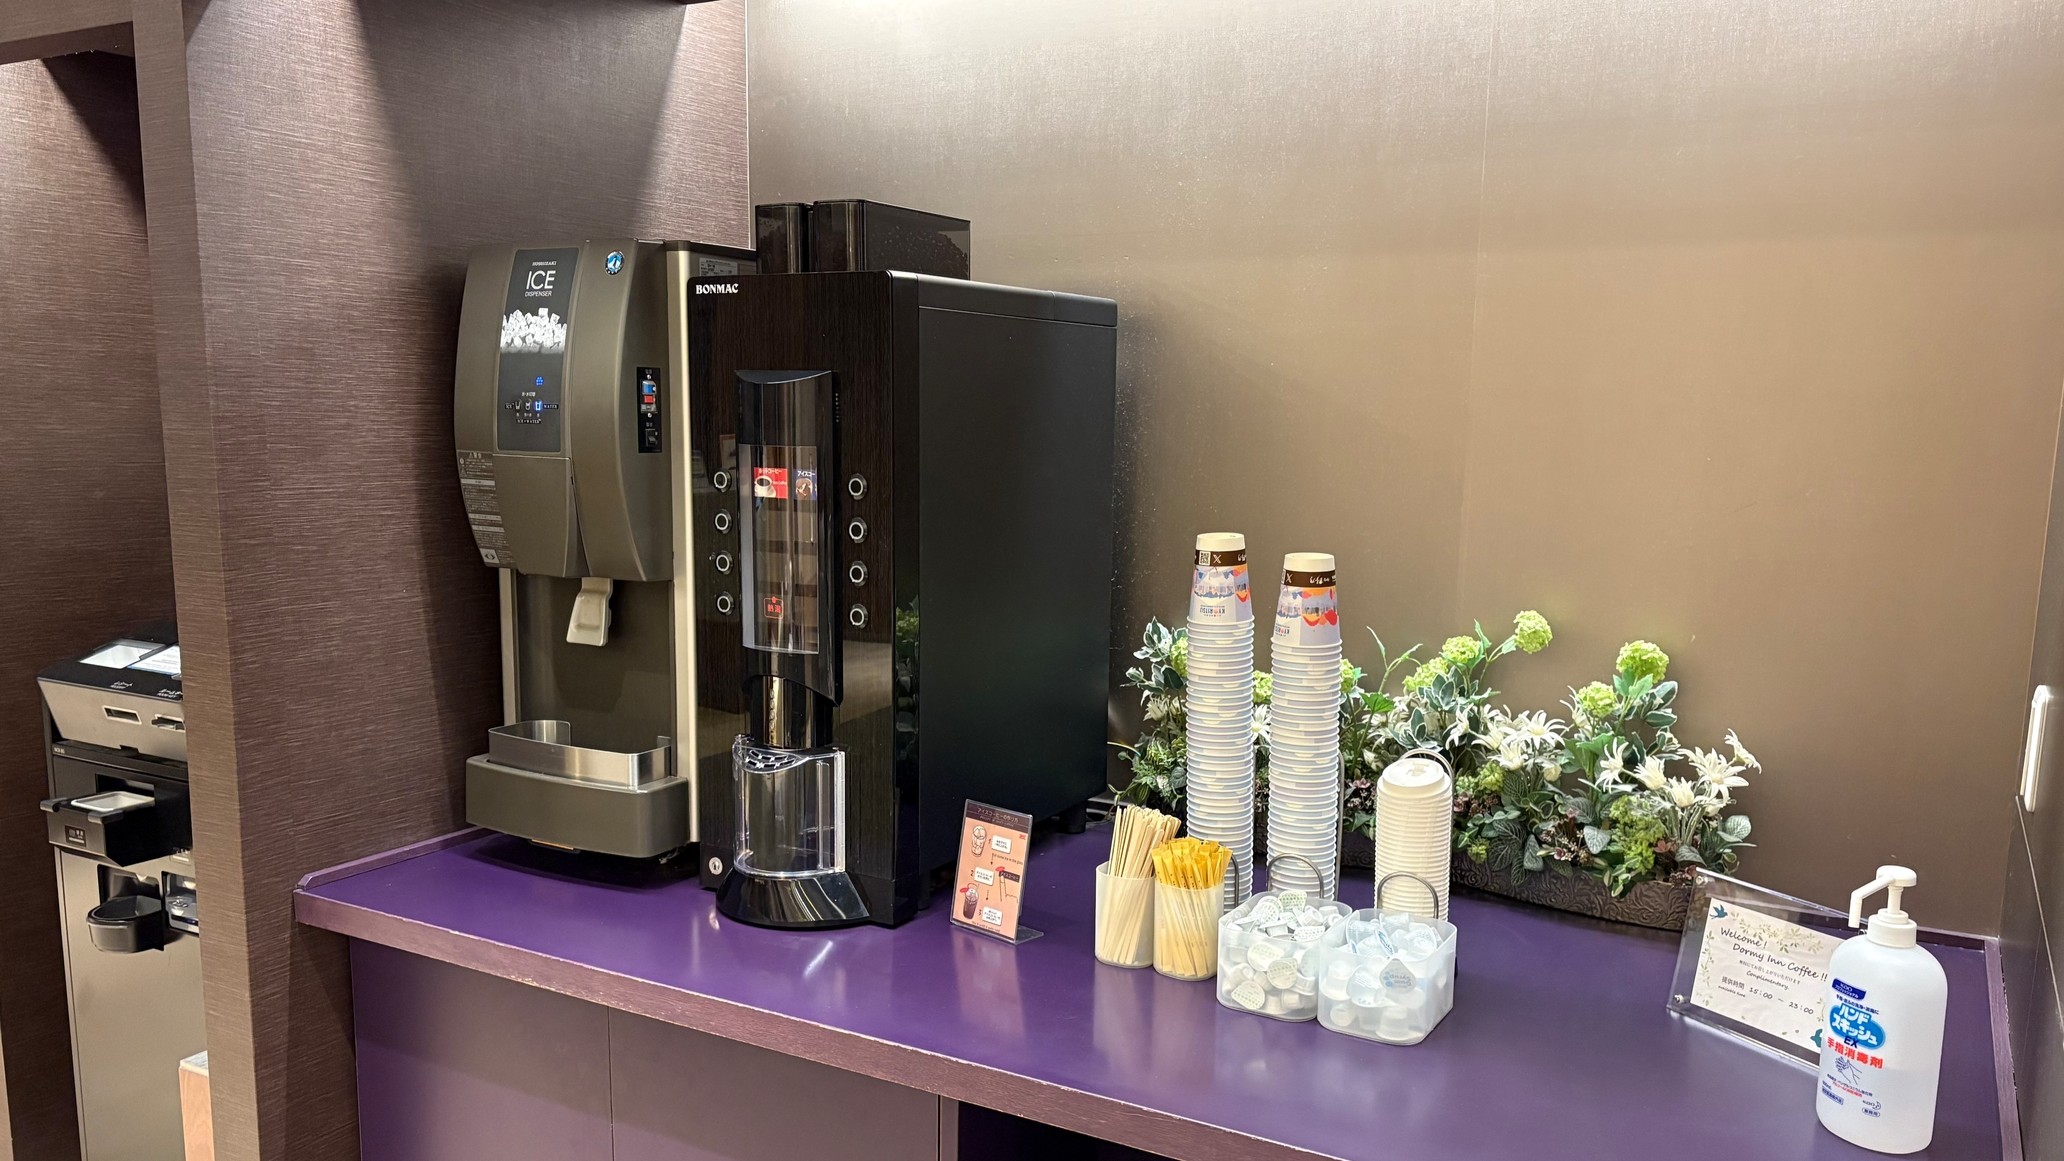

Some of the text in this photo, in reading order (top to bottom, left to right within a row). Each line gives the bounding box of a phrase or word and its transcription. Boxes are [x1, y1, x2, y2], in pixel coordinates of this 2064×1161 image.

[526, 270, 556, 290] ICE
[695, 283, 739, 295] BONMAC
[1732, 943, 1765, 962] Dormy
[1767, 954, 1786, 967] Inn
[1721, 976, 1745, 990] 提供時間
[1839, 1004, 1870, 1024] ハンド
[1831, 1013, 1878, 1046] スキッシュ
[1827, 1036, 1883, 1069] 手指消毒剤
[1844, 1036, 1859, 1049] EX
